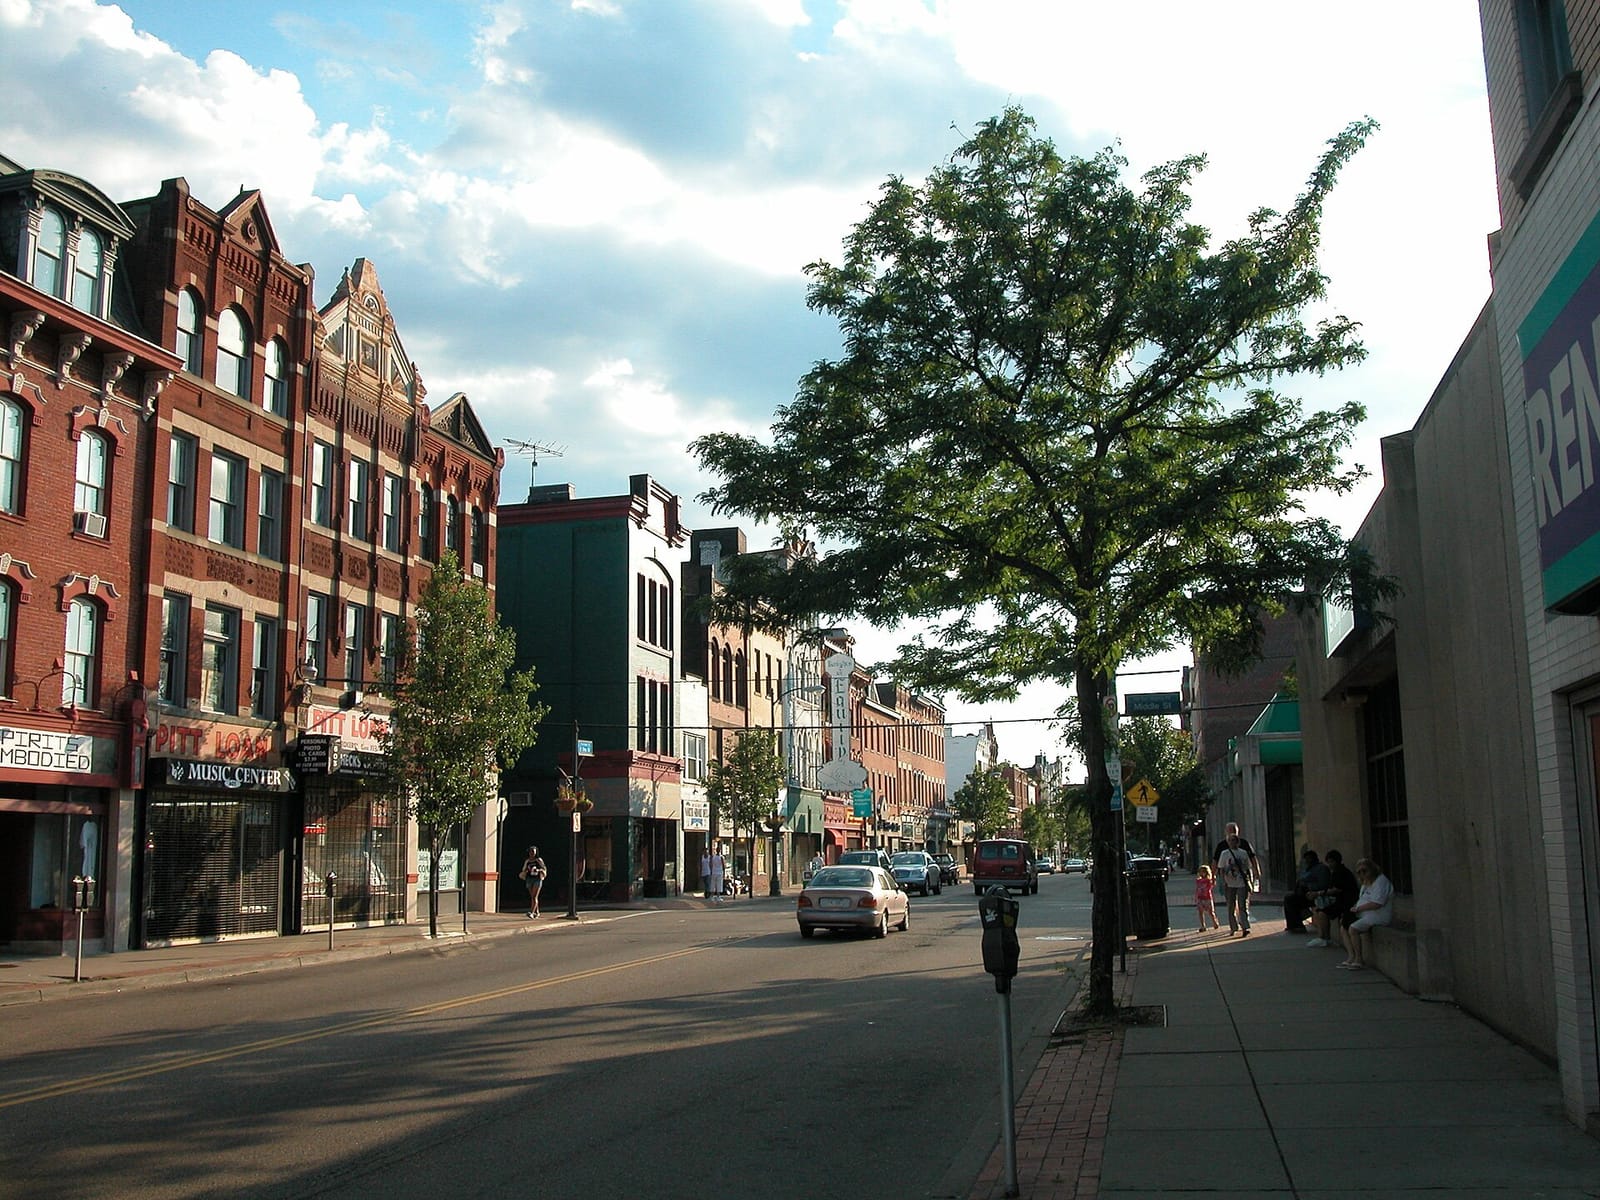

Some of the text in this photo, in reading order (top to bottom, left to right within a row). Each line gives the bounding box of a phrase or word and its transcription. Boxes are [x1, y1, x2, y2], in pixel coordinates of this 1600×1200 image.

[312, 708, 347, 736] PITT
[155, 724, 269, 762] PITT LOAN
[188, 763, 231, 782] MUSIC
[235, 767, 282, 786] CENTER
